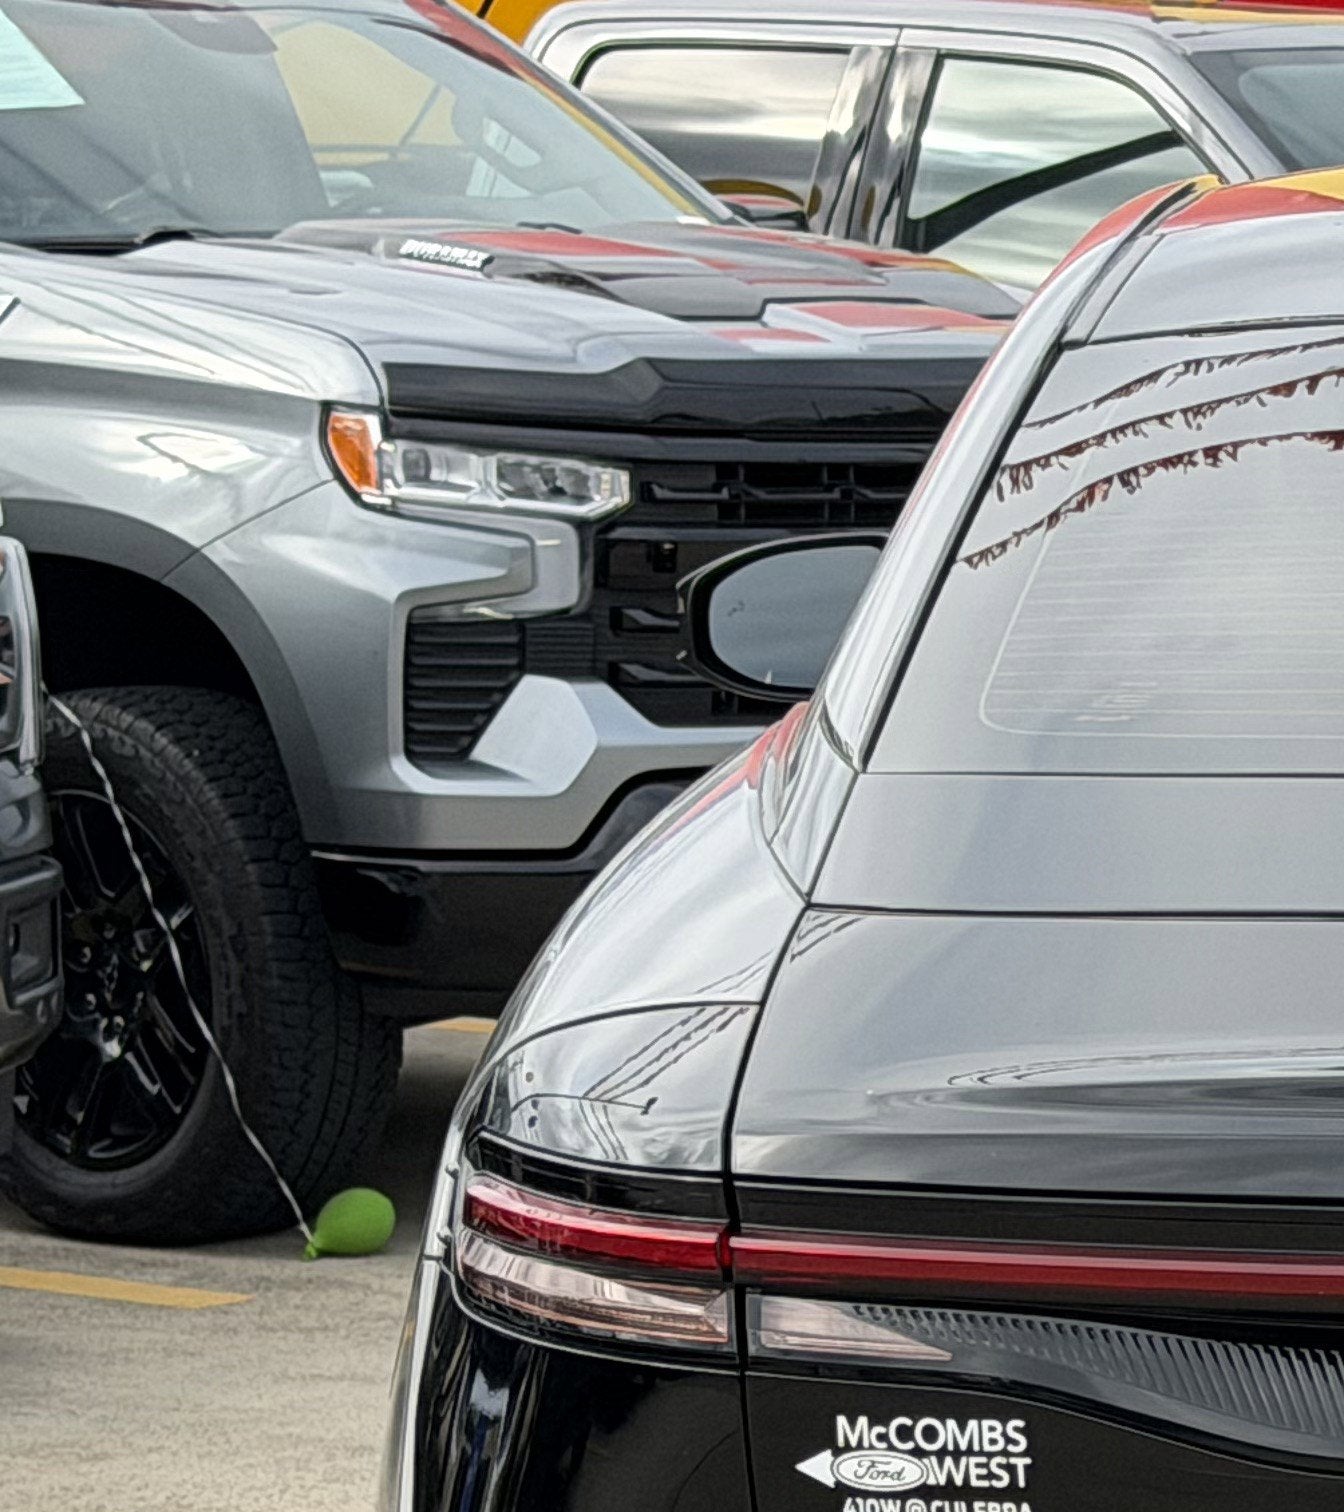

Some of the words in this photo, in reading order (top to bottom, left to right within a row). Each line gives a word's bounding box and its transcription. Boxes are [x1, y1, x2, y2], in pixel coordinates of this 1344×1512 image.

[836, 1415, 1027, 1453] McCOMBS
[853, 1459, 906, 1483] Ford
[931, 1456, 1032, 1488] WEST
